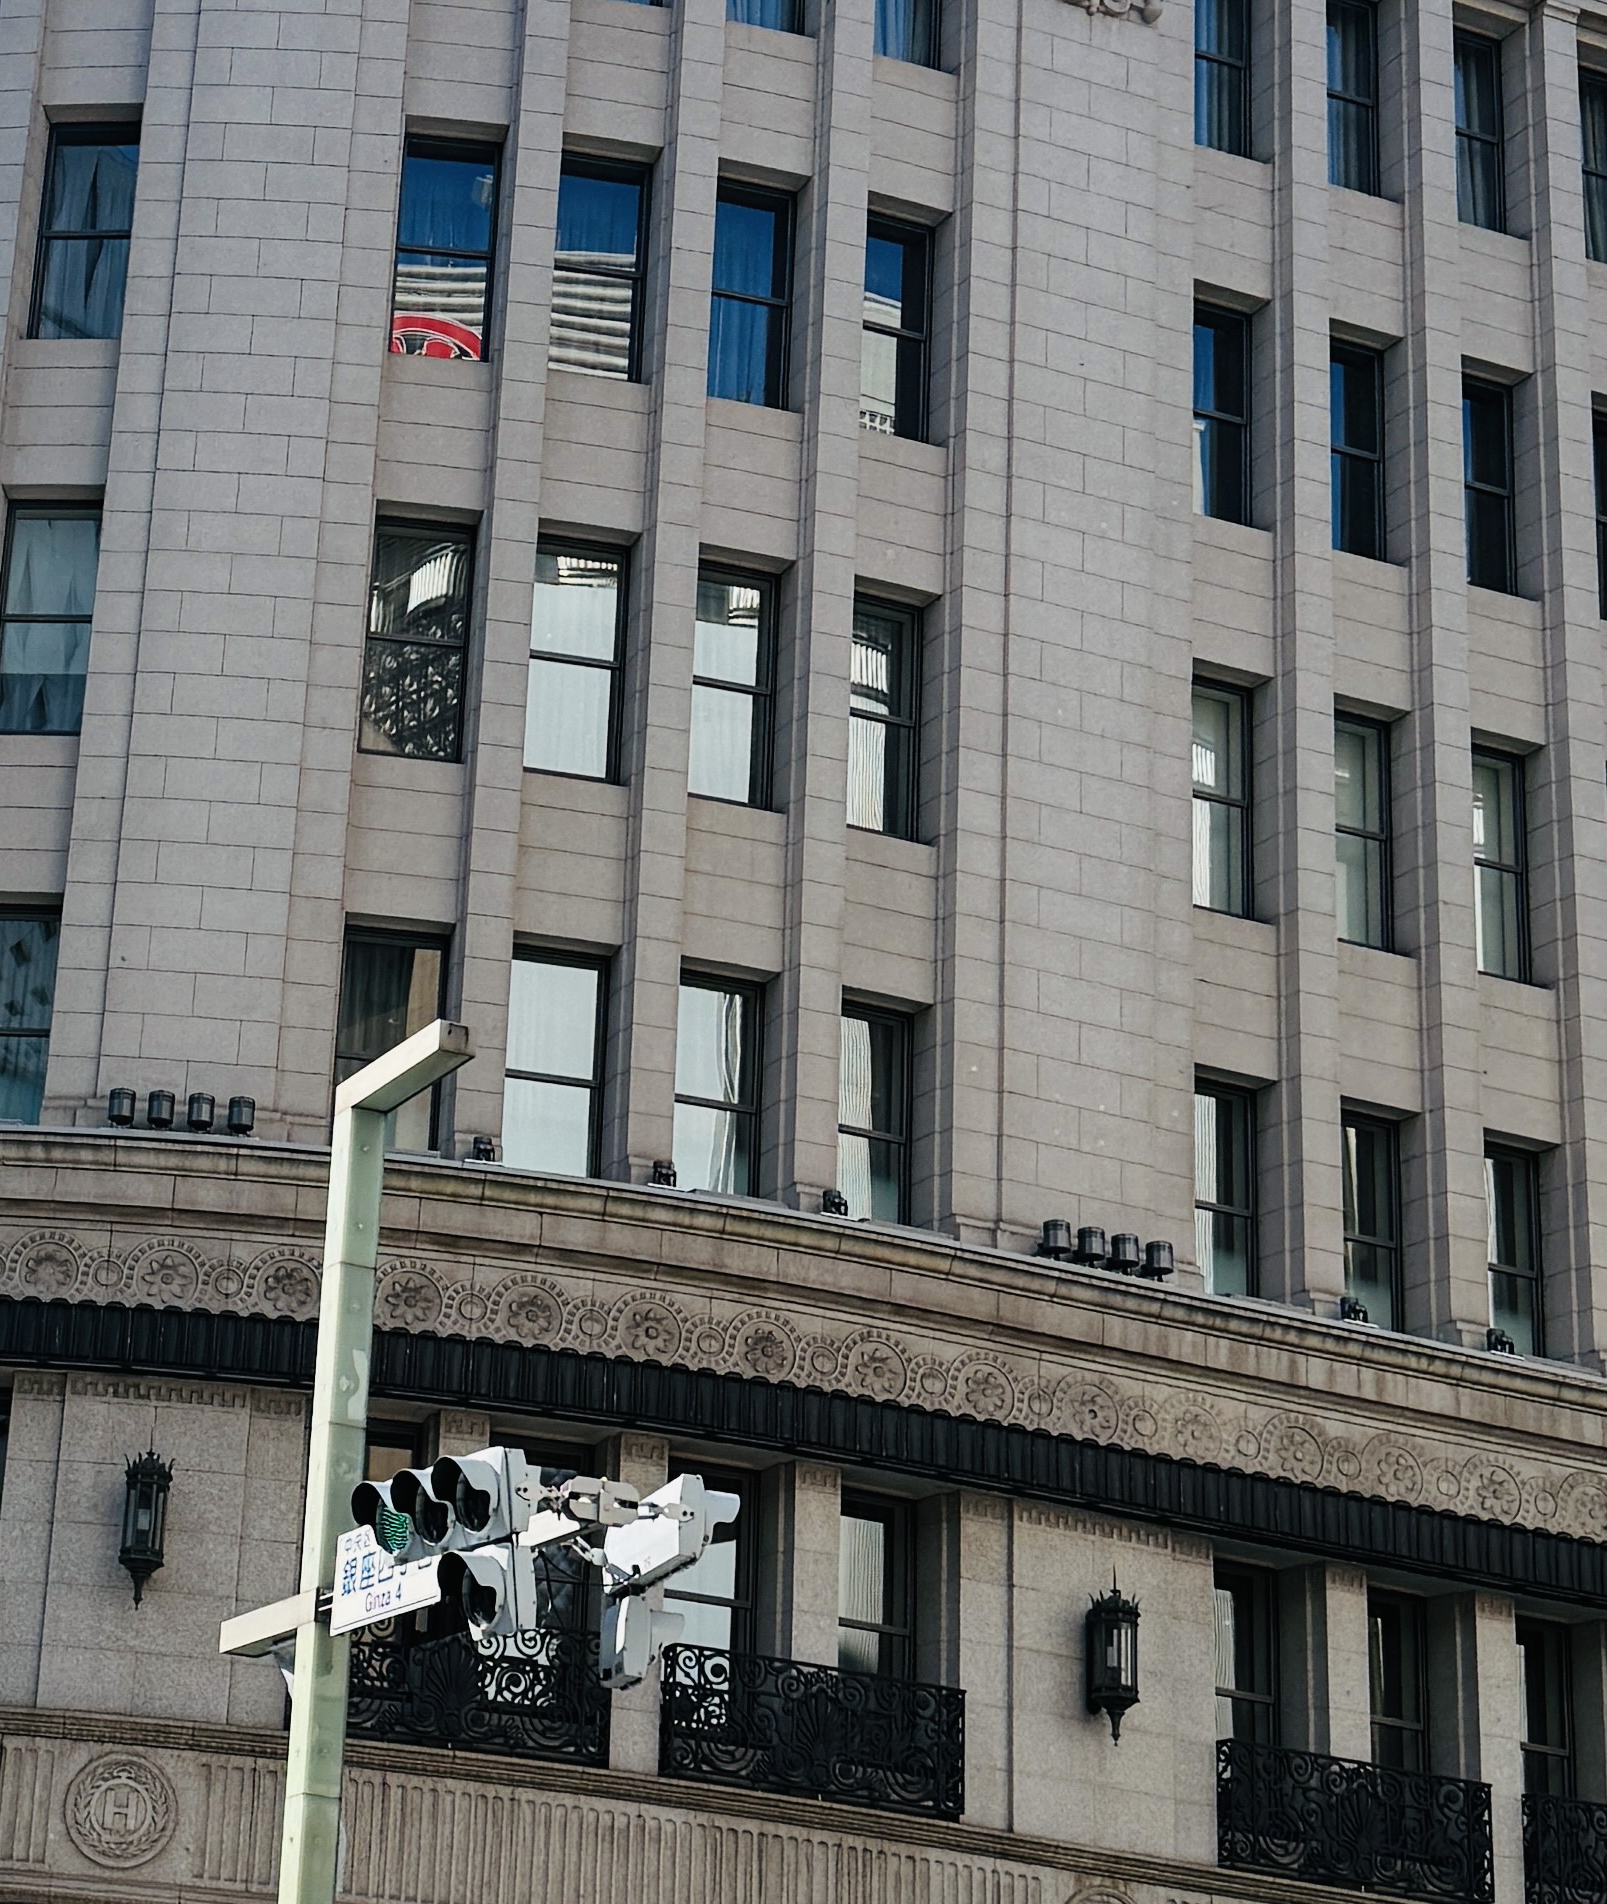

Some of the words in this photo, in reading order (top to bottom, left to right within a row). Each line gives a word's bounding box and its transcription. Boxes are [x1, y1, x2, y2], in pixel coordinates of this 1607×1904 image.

[342, 1550, 433, 1596] 銀座四
[365, 1591, 391, 1613] Ginza
[395, 1581, 403, 1601] 4
[102, 1788, 138, 1833] H
